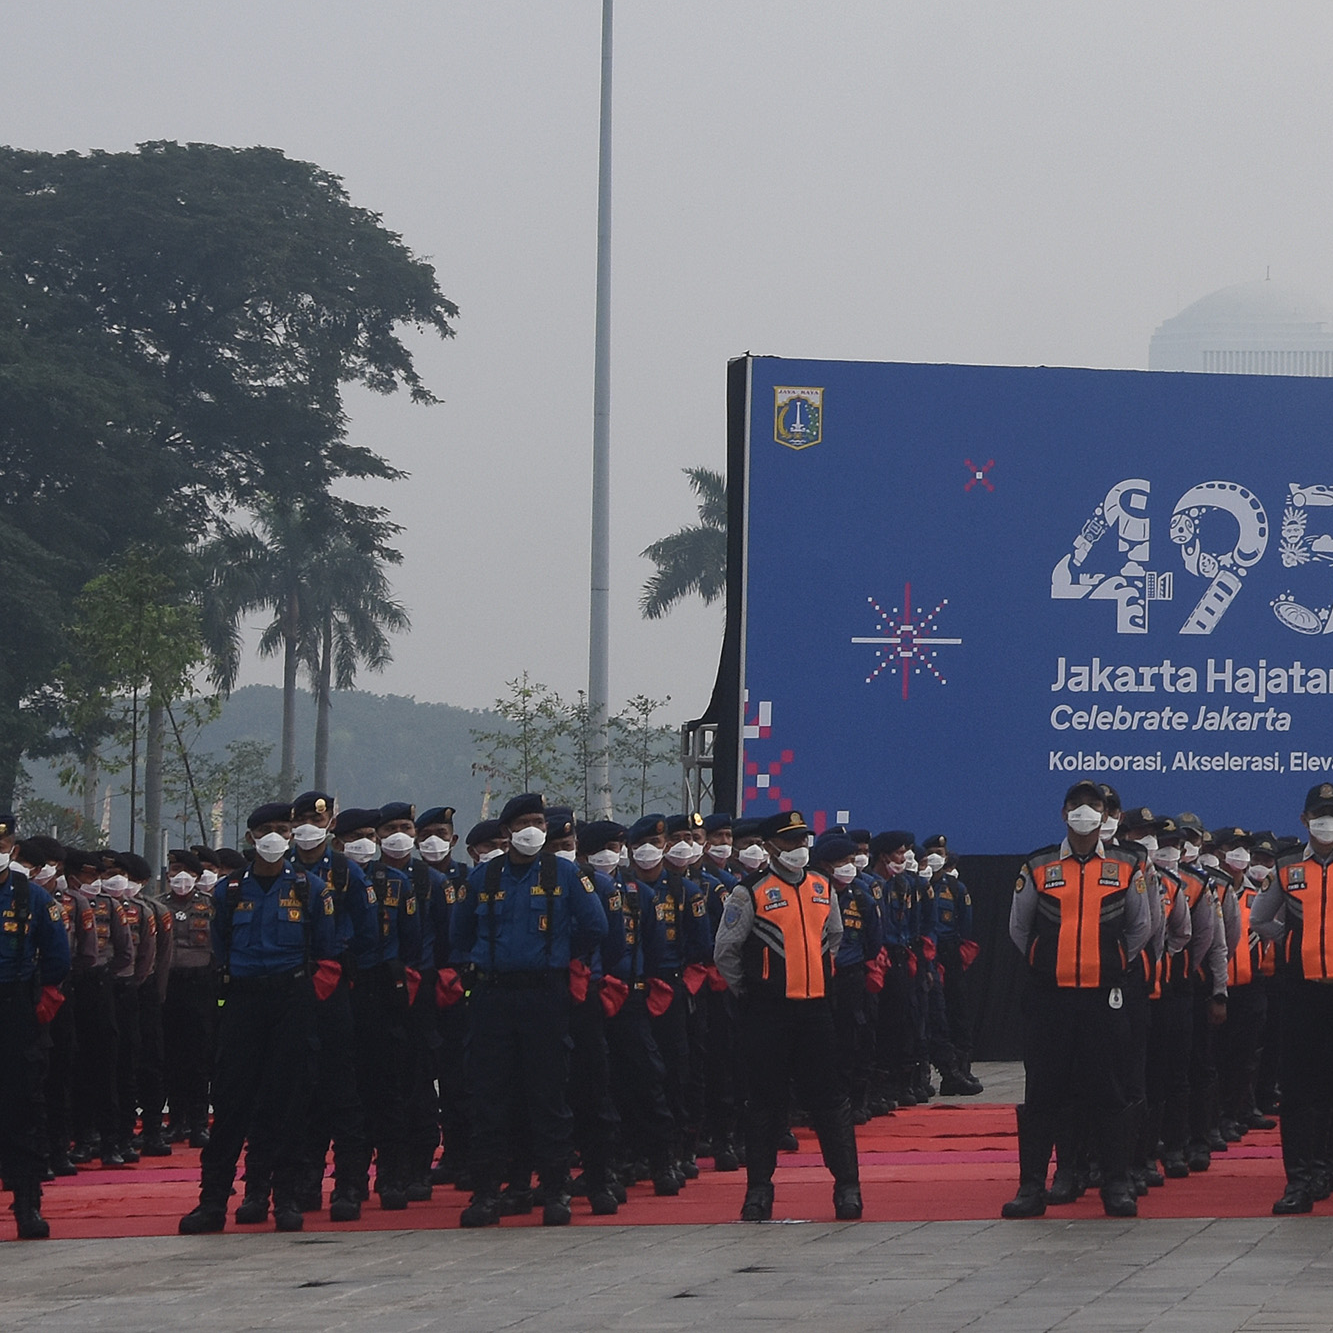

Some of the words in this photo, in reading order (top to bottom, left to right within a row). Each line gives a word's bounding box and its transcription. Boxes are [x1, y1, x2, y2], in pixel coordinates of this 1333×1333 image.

[1051, 657, 1198, 693] Jakarta
[1050, 705, 1189, 731] Celebrate
[1192, 705, 1292, 732] Jakarta
[1049, 751, 1167, 774] Kolaborasi,
[1171, 751, 1286, 774] Akselerasi,
